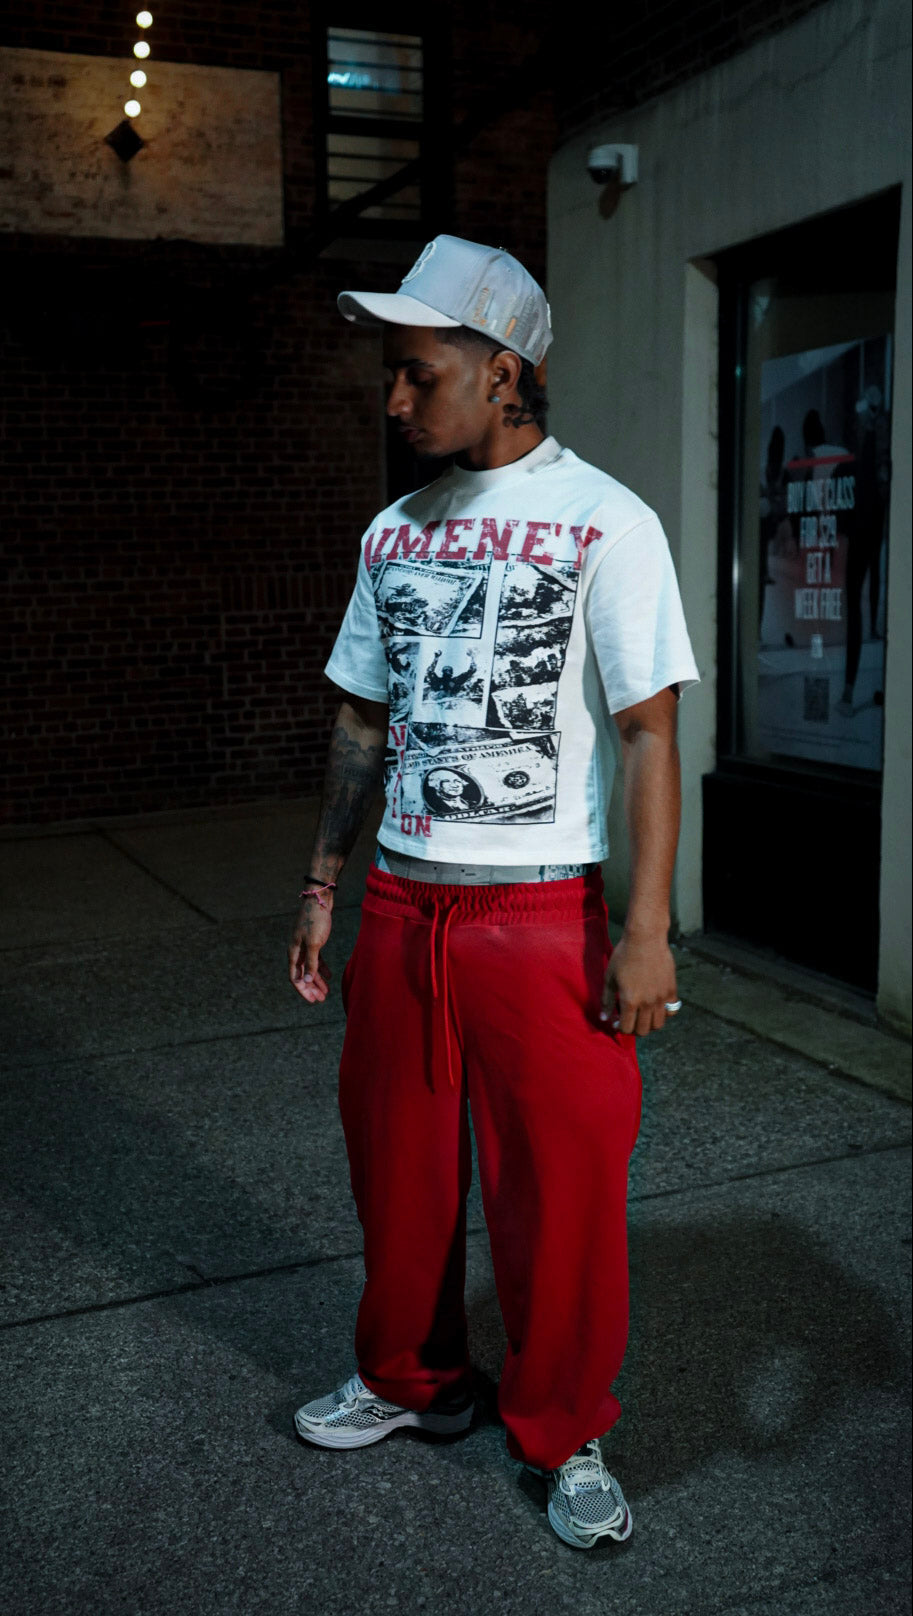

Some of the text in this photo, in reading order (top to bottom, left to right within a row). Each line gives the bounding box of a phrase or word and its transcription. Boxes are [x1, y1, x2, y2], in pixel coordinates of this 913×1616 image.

[824, 475, 856, 511] CLASS
[806, 551, 832, 584] GET A
[794, 587, 843, 620] WEEK FREE
